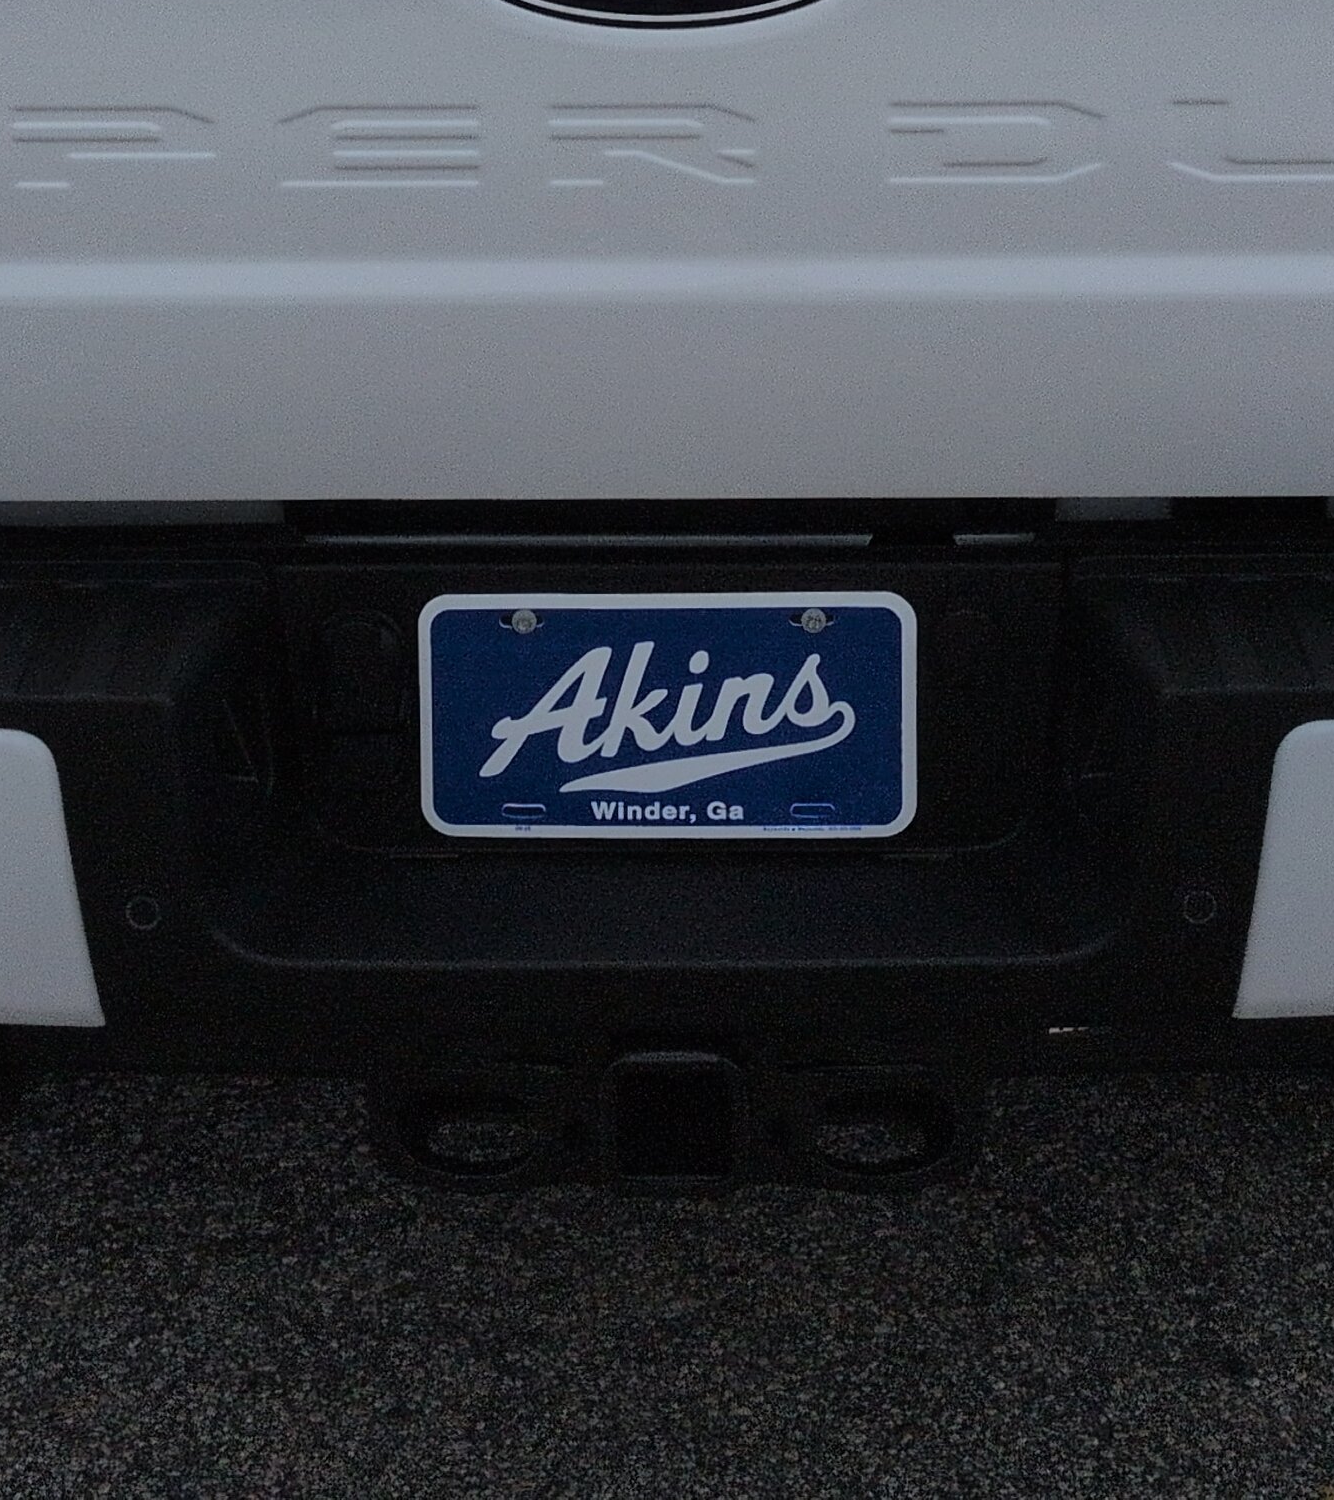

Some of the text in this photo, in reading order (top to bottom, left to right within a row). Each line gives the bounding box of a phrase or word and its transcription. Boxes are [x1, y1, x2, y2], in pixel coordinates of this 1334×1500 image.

[479, 640, 856, 793] Akins
[590, 801, 744, 823] Winder, Ga
